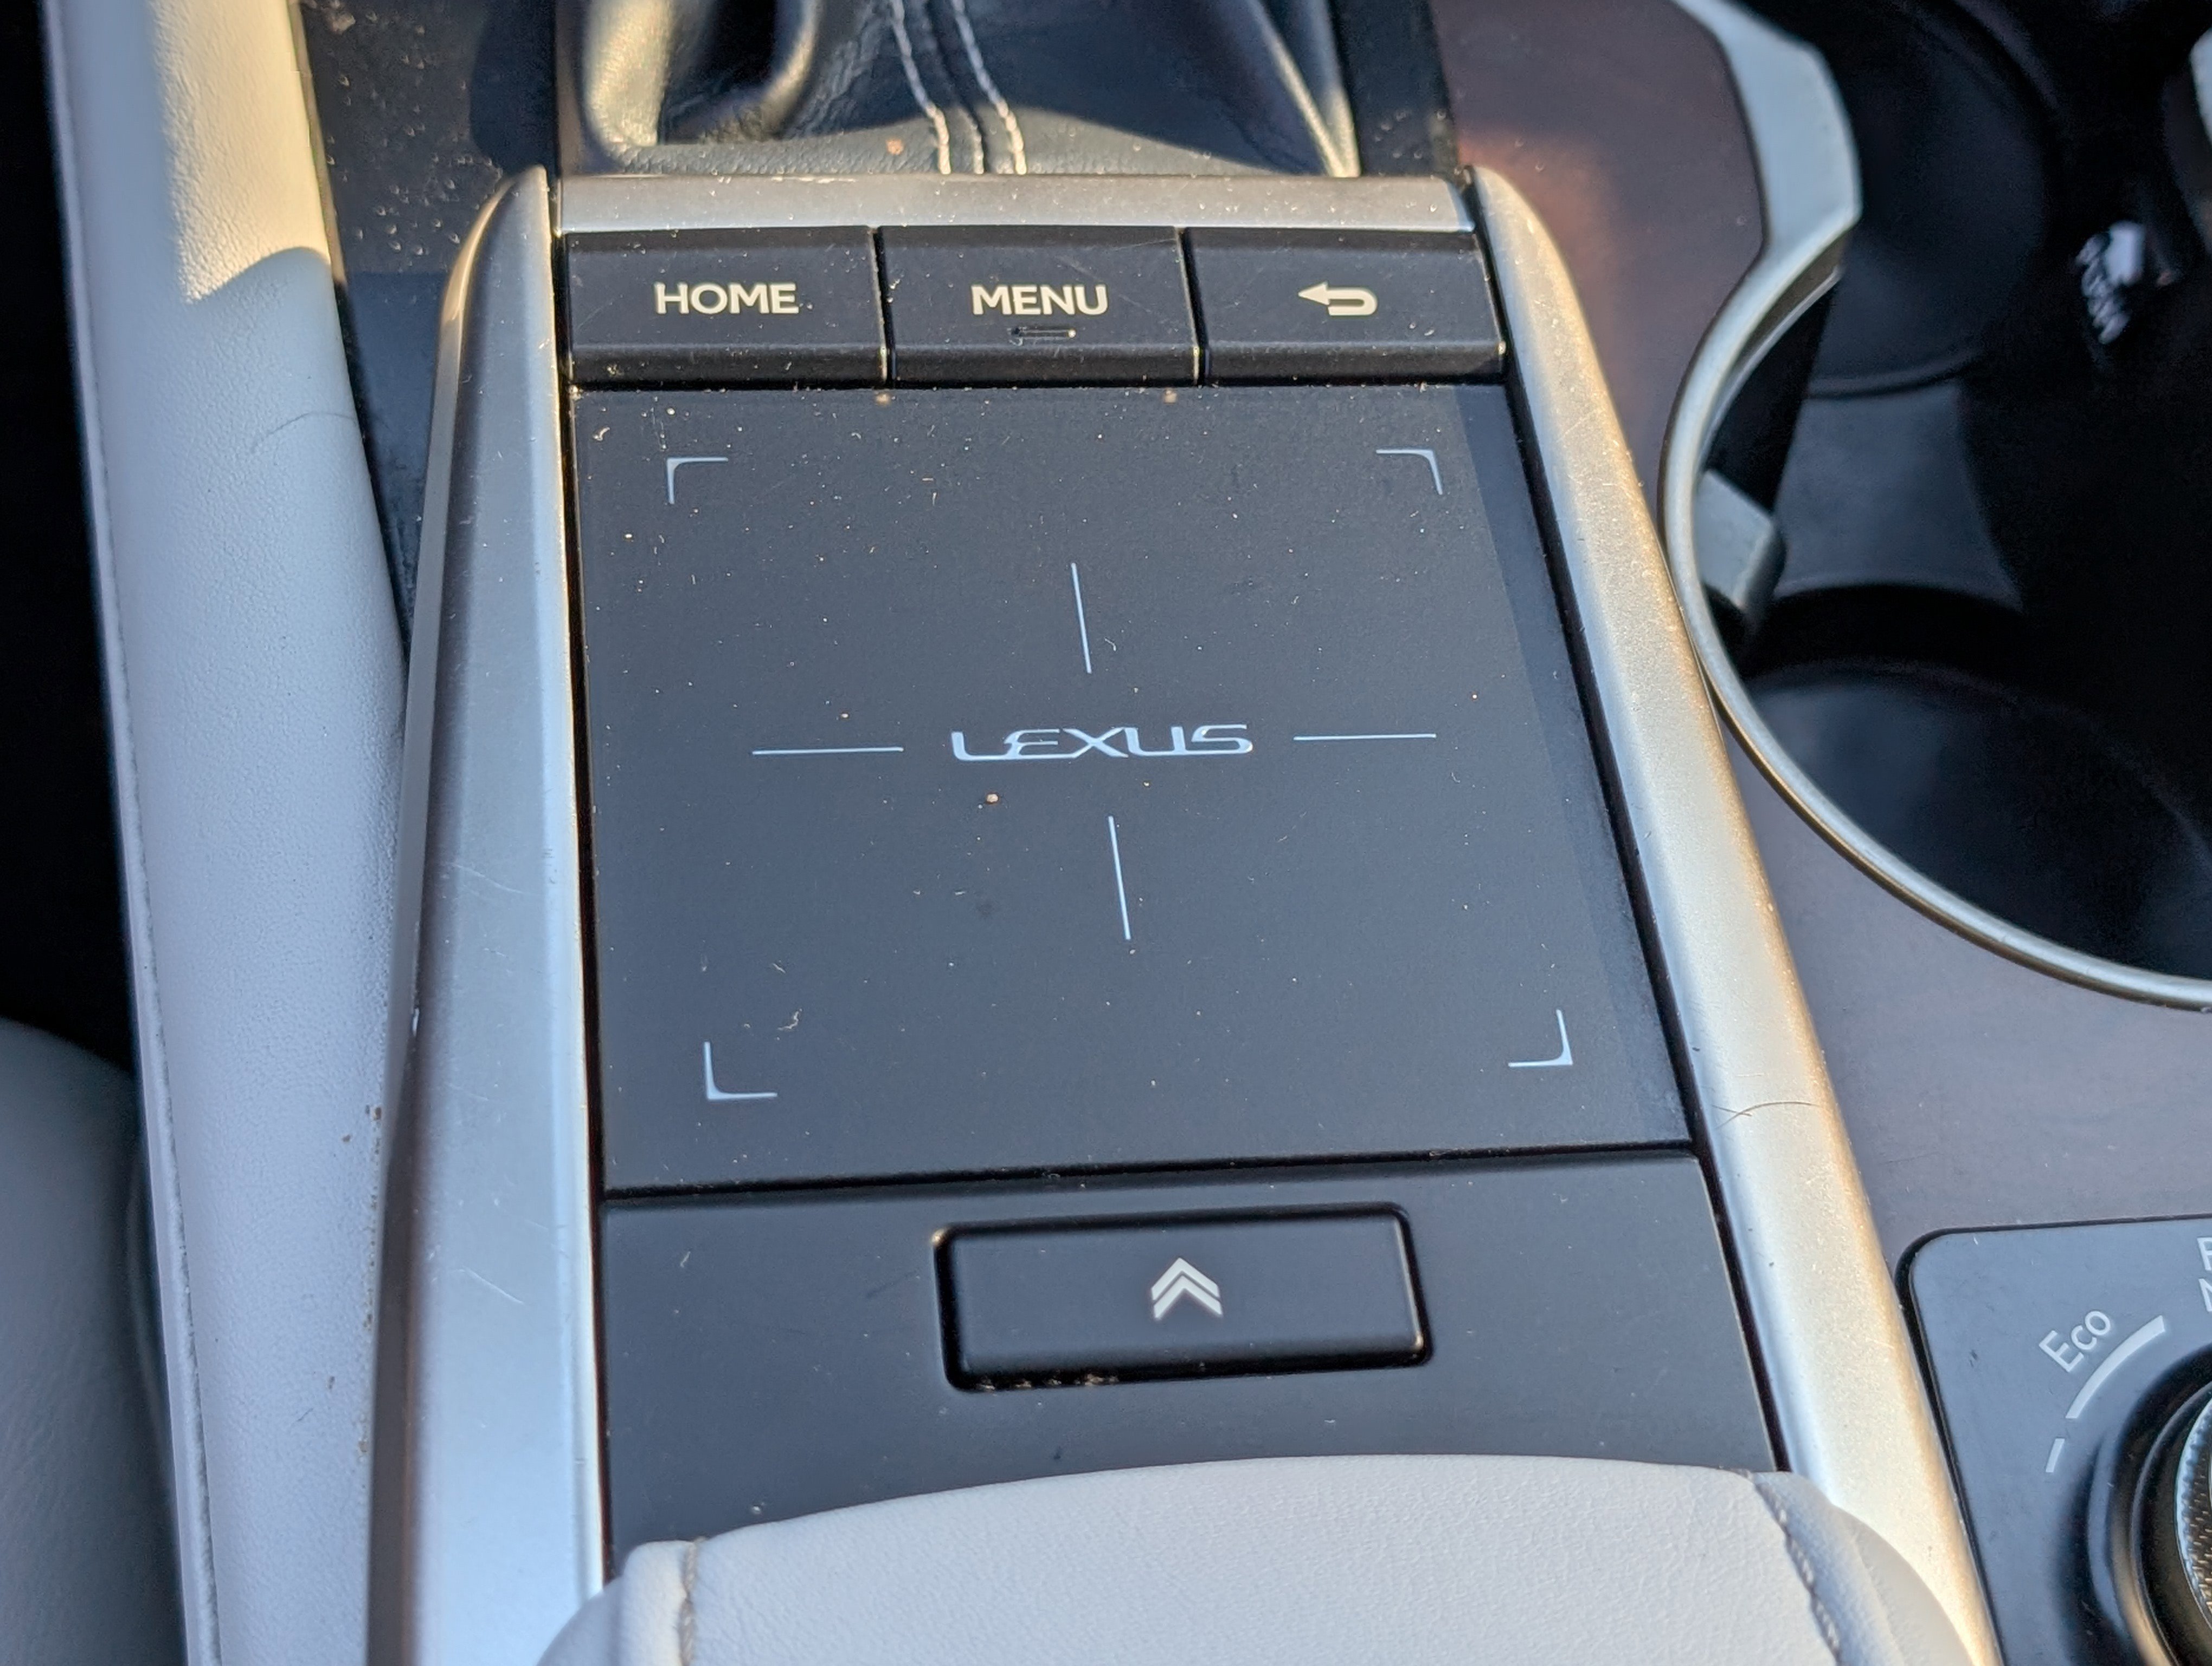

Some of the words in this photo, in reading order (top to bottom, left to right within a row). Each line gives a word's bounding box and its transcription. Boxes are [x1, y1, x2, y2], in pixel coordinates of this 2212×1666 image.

[654, 282, 799, 315] HOME
[971, 284, 1109, 316] MENU
[951, 724, 1253, 761] LEXUS
[2039, 1310, 2111, 1373] Eco
